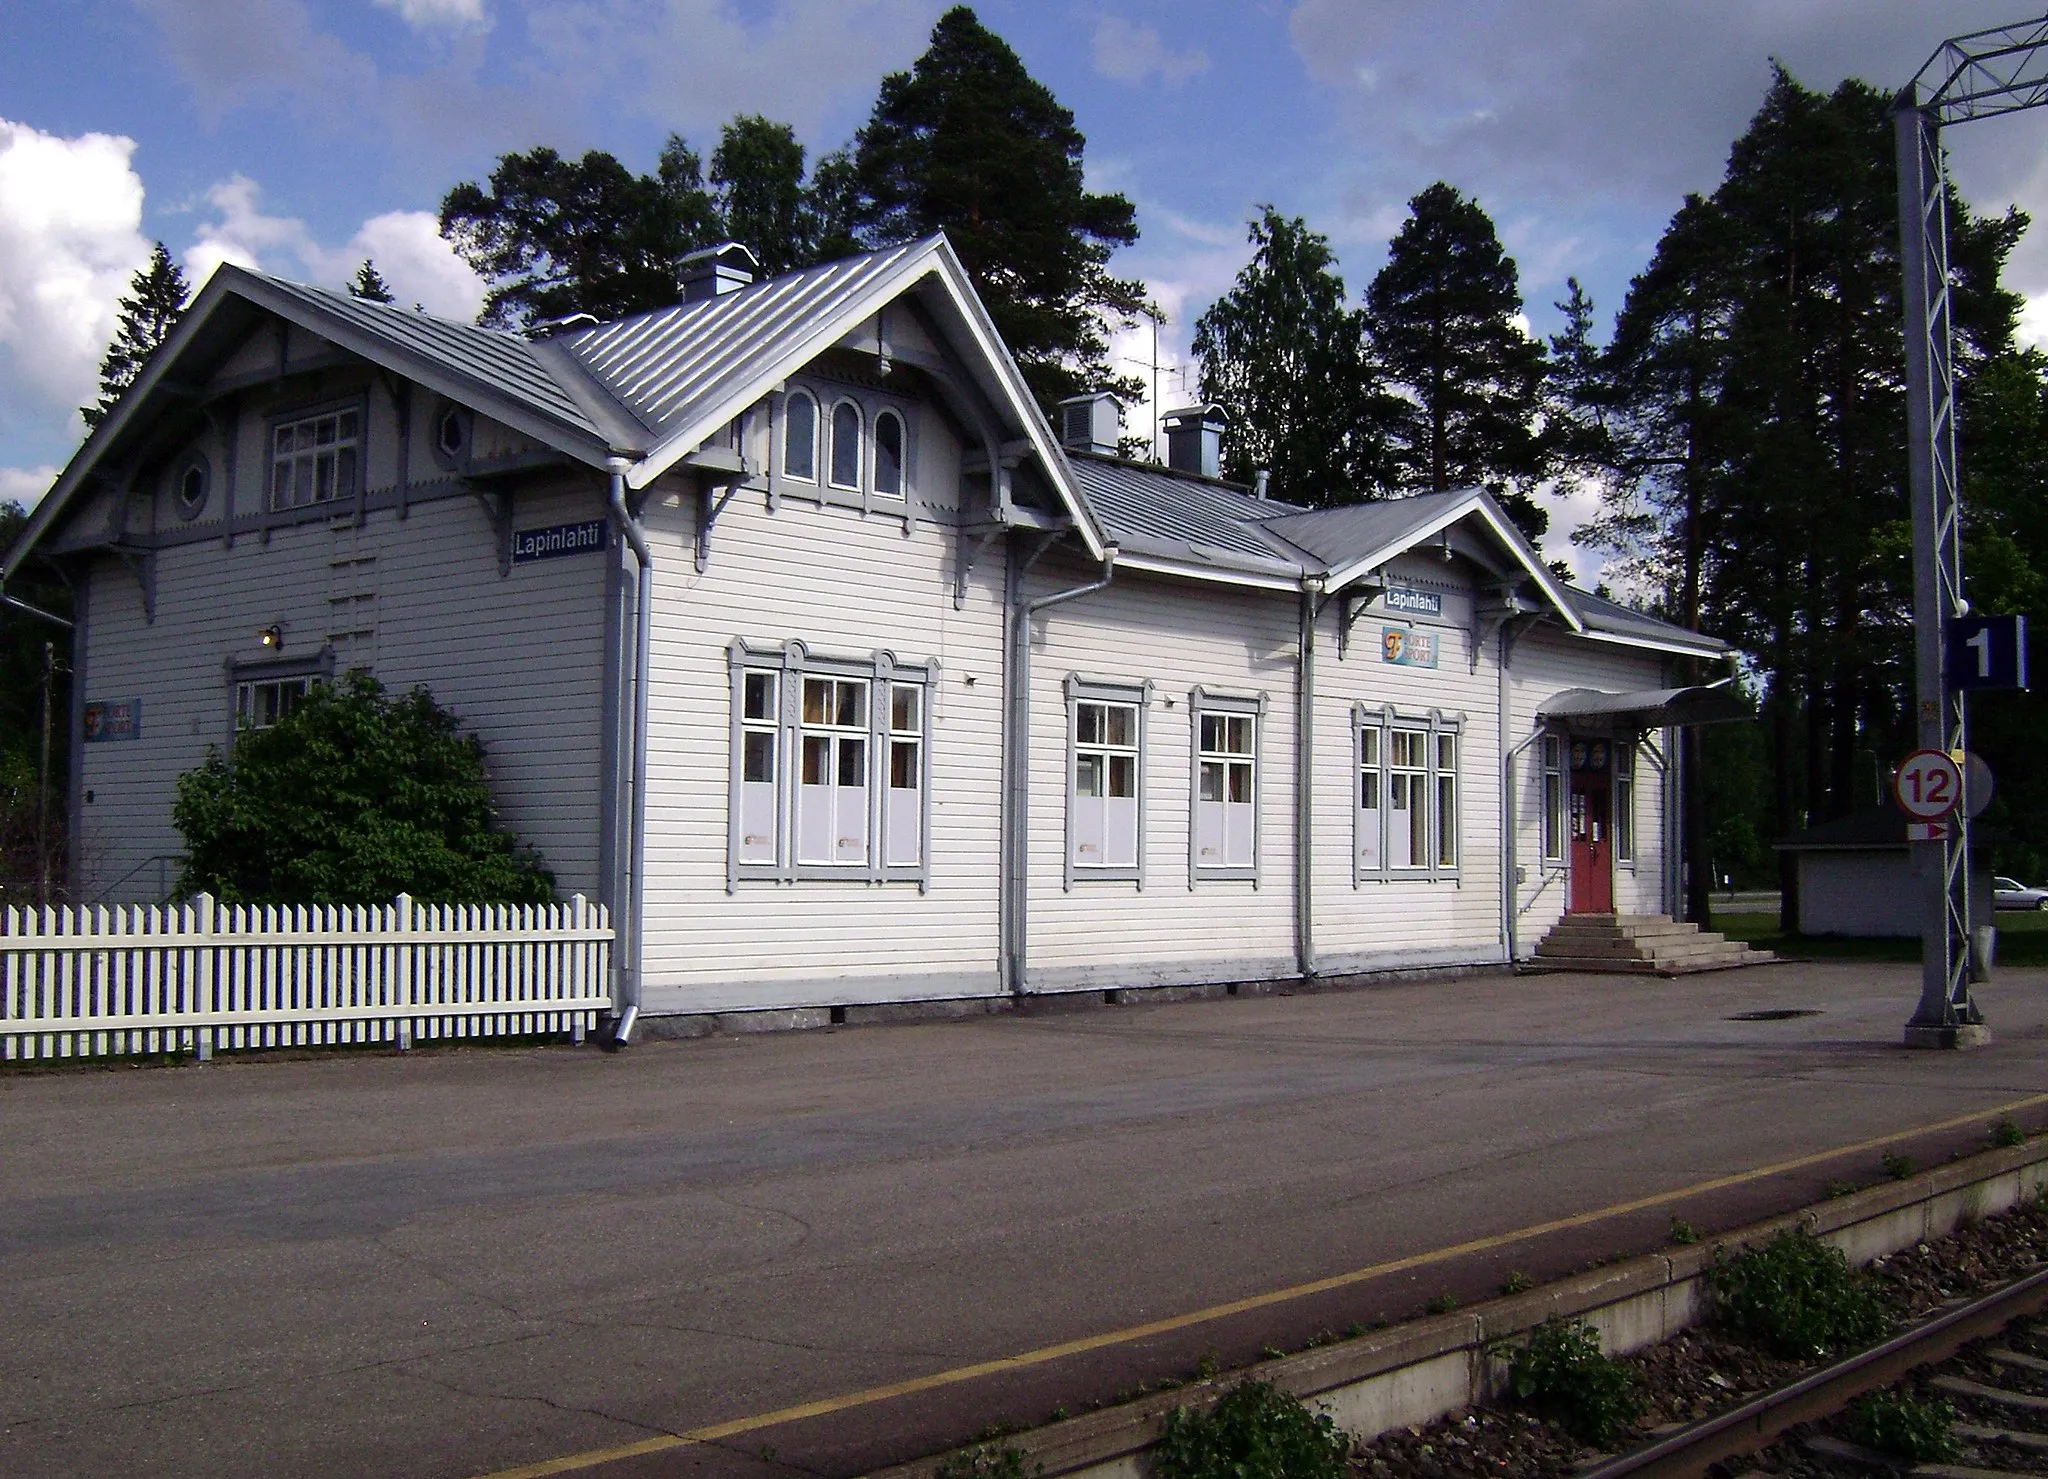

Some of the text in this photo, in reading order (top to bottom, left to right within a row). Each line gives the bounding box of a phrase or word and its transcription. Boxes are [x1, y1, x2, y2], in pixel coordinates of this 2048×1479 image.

[516, 523, 599, 556] Lapinlahti
[1387, 591, 1438, 611] Lapinlahti
[1966, 627, 1989, 677] 1
[1904, 768, 1950, 803] 12
